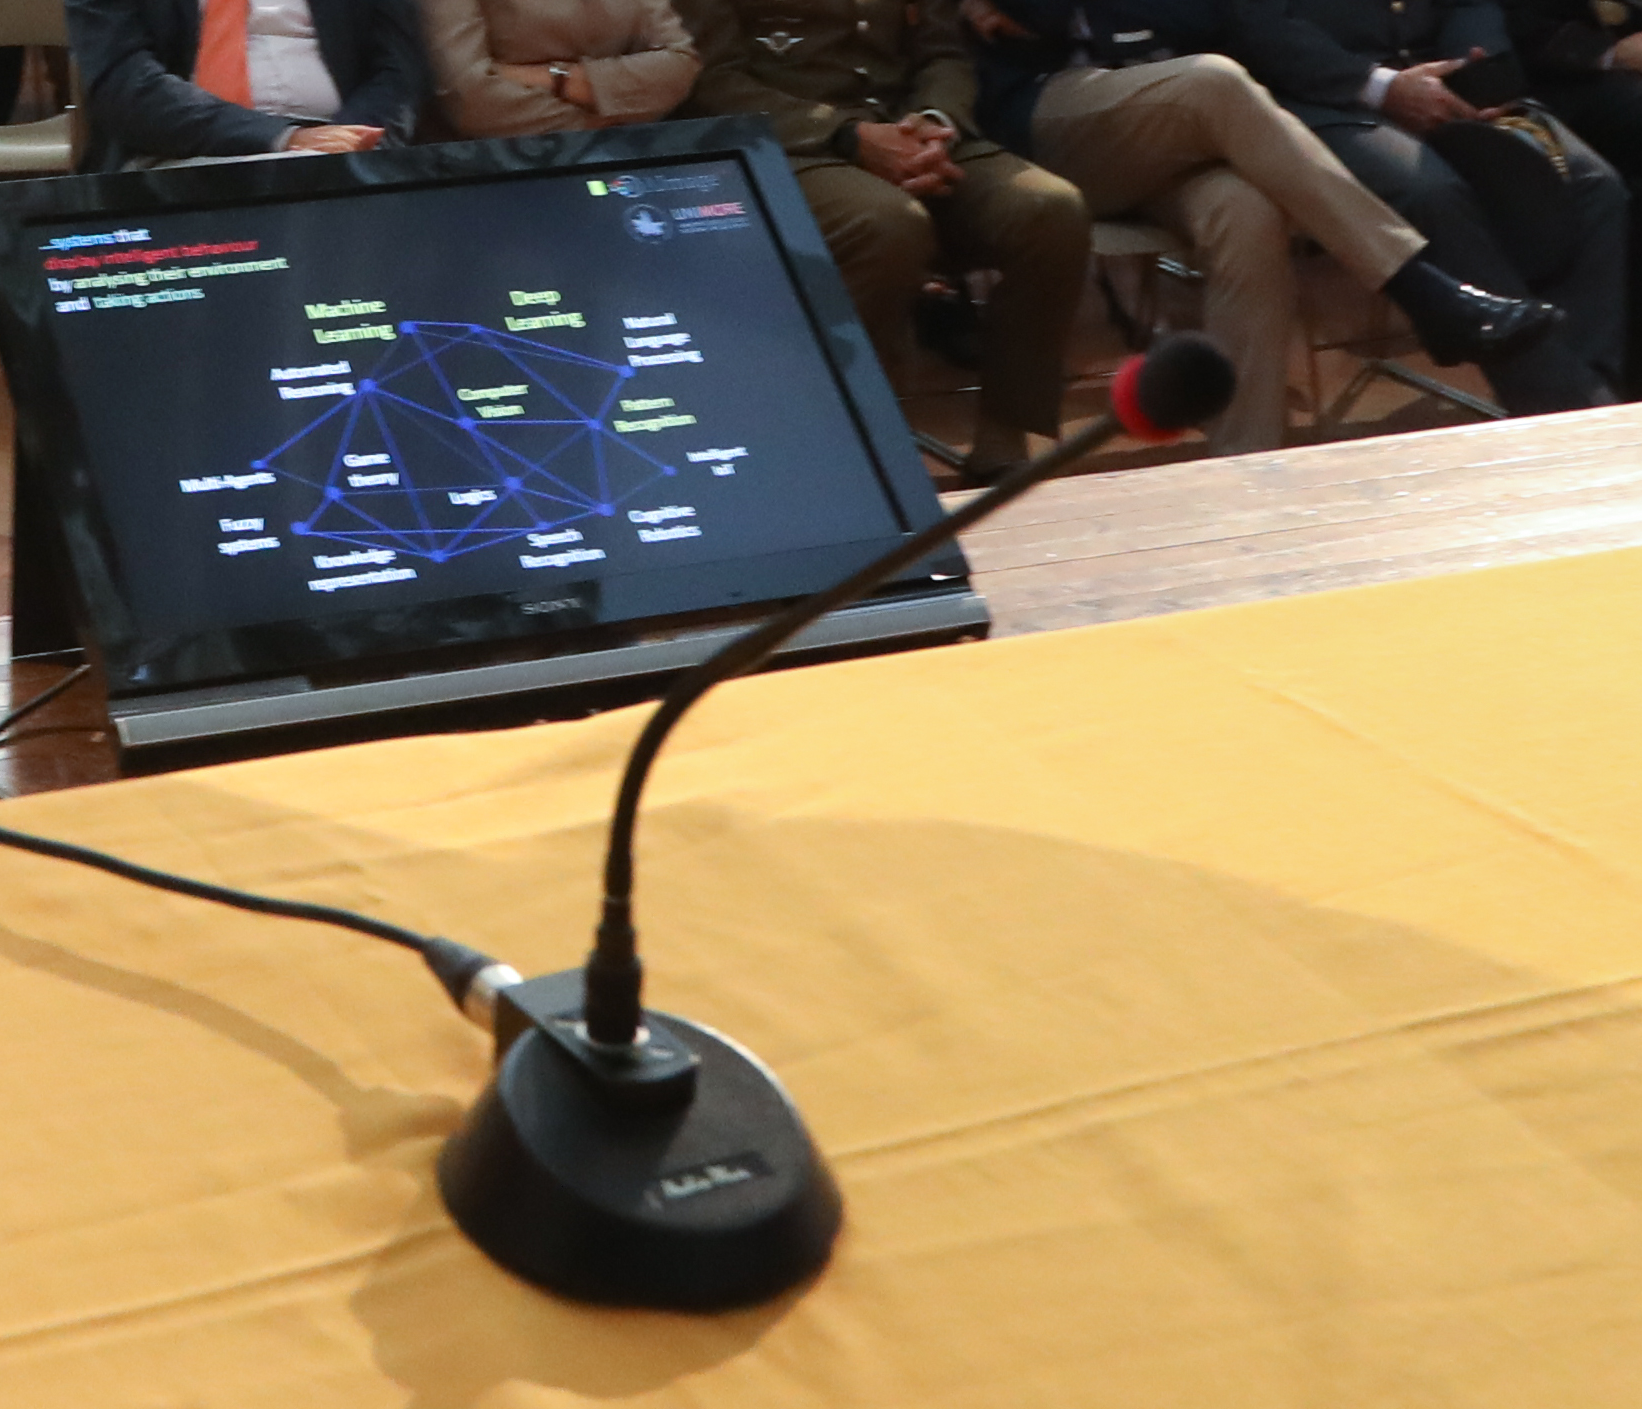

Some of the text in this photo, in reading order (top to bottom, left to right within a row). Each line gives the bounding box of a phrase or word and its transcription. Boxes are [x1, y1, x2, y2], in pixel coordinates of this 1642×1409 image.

[114, 229, 152, 243] that
[43, 255, 102, 271] display
[103, 246, 180, 265] intelligent
[47, 277, 73, 293] by
[146, 266, 187, 282] their
[187, 257, 290, 278] environment
[55, 288, 206, 313] and taking actions
[508, 290, 562, 306] Deep
[304, 299, 387, 319] Machine
[504, 311, 587, 331] Learning
[622, 312, 678, 330] Natural
[313, 323, 397, 344] Learning
[623, 333, 692, 349] Language
[270, 360, 352, 381] Automated
[278, 381, 356, 400] Reasoning
[456, 384, 529, 401] Computer
[474, 404, 525, 418] Vision
[619, 398, 675, 412] Pattern
[613, 414, 698, 432] Recognition
[342, 453, 392, 467] Game
[685, 446, 750, 462] Intelligent
[179, 472, 277, 493] Multi-Agents
[447, 489, 497, 506] Logics
[627, 505, 696, 524] Cognitive
[218, 517, 265, 532] Fuzzy
[526, 529, 584, 548] Speech
[637, 525, 703, 543] Robotics
[312, 548, 397, 569] Knowledge
[519, 548, 607, 569] Recognition
[520, 597, 582, 615] SONY
